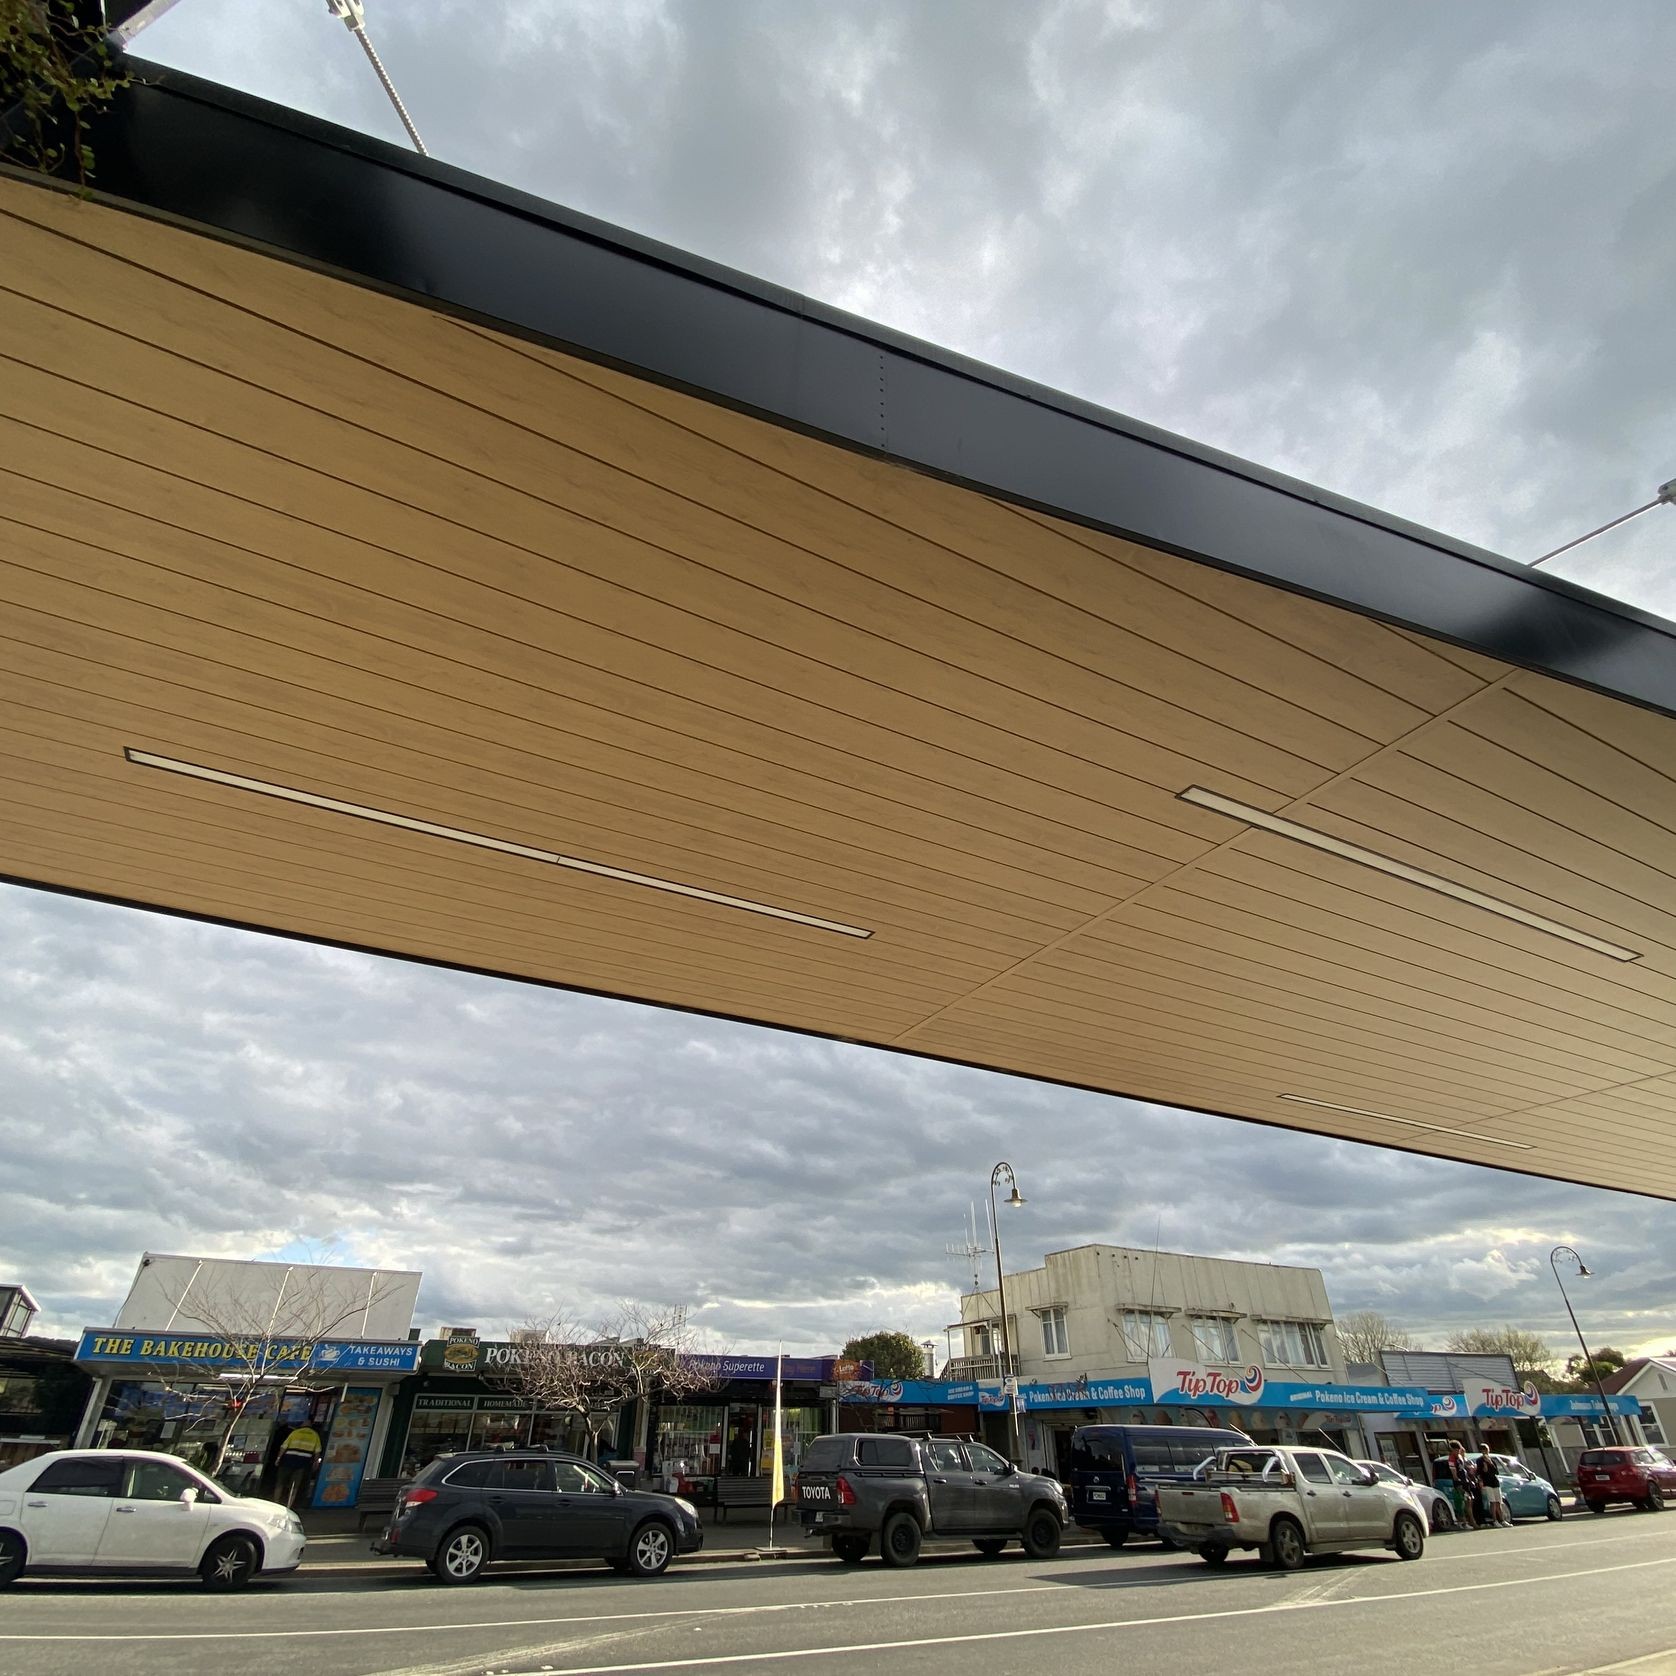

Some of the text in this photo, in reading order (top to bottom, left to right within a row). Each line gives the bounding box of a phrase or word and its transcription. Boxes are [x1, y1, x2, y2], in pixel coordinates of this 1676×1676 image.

[92, 1337, 135, 1355] THE
[350, 1345, 413, 1356] TAKEAWAYS
[358, 1357, 400, 1366] & SUSHI
[484, 1347, 562, 1365] POKE
[723, 1360, 765, 1374] Superette
[1091, 1386, 1098, 1400] &
[1098, 1386, 1123, 1400] Coffee
[1124, 1384, 1146, 1400] Shop
[1315, 1390, 1343, 1403] Pokeno
[1344, 1392, 1356, 1404] Ice
[1356, 1392, 1377, 1405] Cream
[1378, 1393, 1385, 1405] &
[1385, 1393, 1406, 1406] Coffee
[1406, 1394, 1424, 1408] Shop
[419, 1399, 472, 1407] TRADITIONAL
[802, 1486, 831, 1500] TOYOTA
